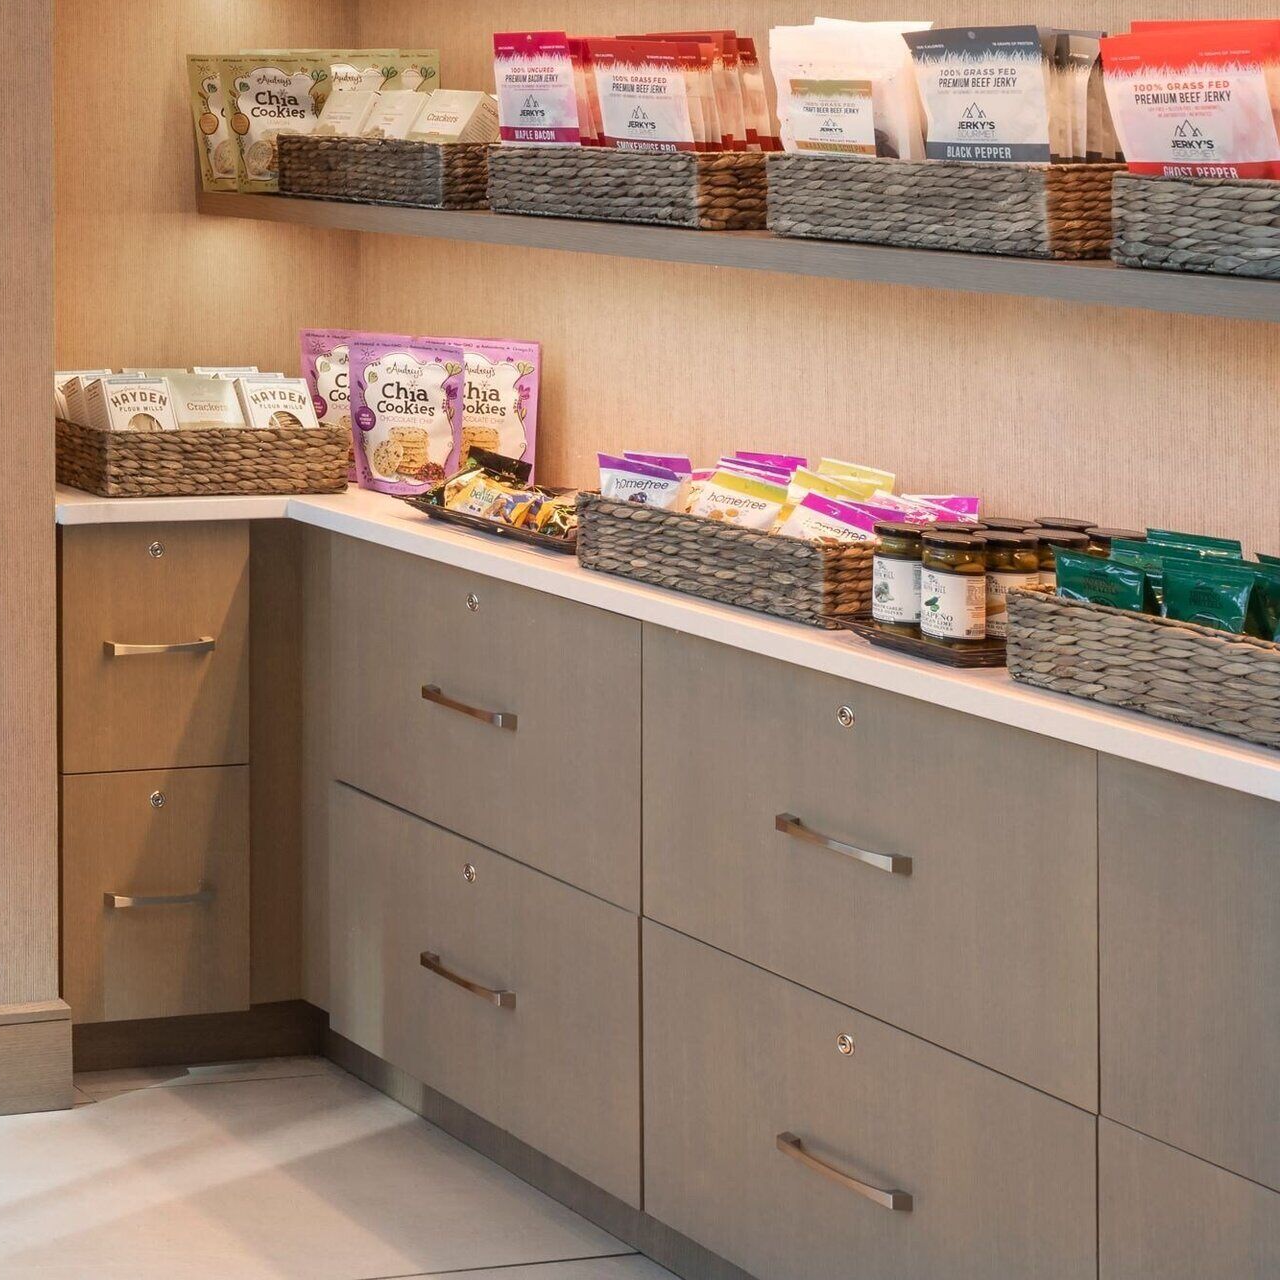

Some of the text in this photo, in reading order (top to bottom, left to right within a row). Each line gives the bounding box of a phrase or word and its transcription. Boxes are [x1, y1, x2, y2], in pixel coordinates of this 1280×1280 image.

[940, 67, 1017, 77] 100% GRASS FED
[630, 75, 652, 84] GRASS
[939, 77, 1018, 88] PREMIUM BEEF JERKY
[1134, 80, 1230, 92] 100% GRASS FED
[612, 83, 667, 94] PREMIUM BEEF JERKY
[255, 90, 299, 107] Chia
[1134, 90, 1231, 105] PREMIUM BEEF JERKY
[251, 106, 306, 119] Cookies
[520, 109, 546, 117] JERKY'S
[627, 121, 657, 129] JERKY'S
[957, 120, 996, 130] JERKY'S
[1170, 139, 1215, 149] JERKY'S
[946, 145, 1012, 159] BLACK PEPPER
[1196, 166, 1238, 179] PEPPER
[250, 390, 307, 406] HAYDEN
[381, 381, 429, 402] Chia
[110, 391, 168, 408] HAYDEN
[377, 400, 436, 417] Cookies
[615, 477, 669, 490] homefree
[707, 491, 768, 511] homefree
